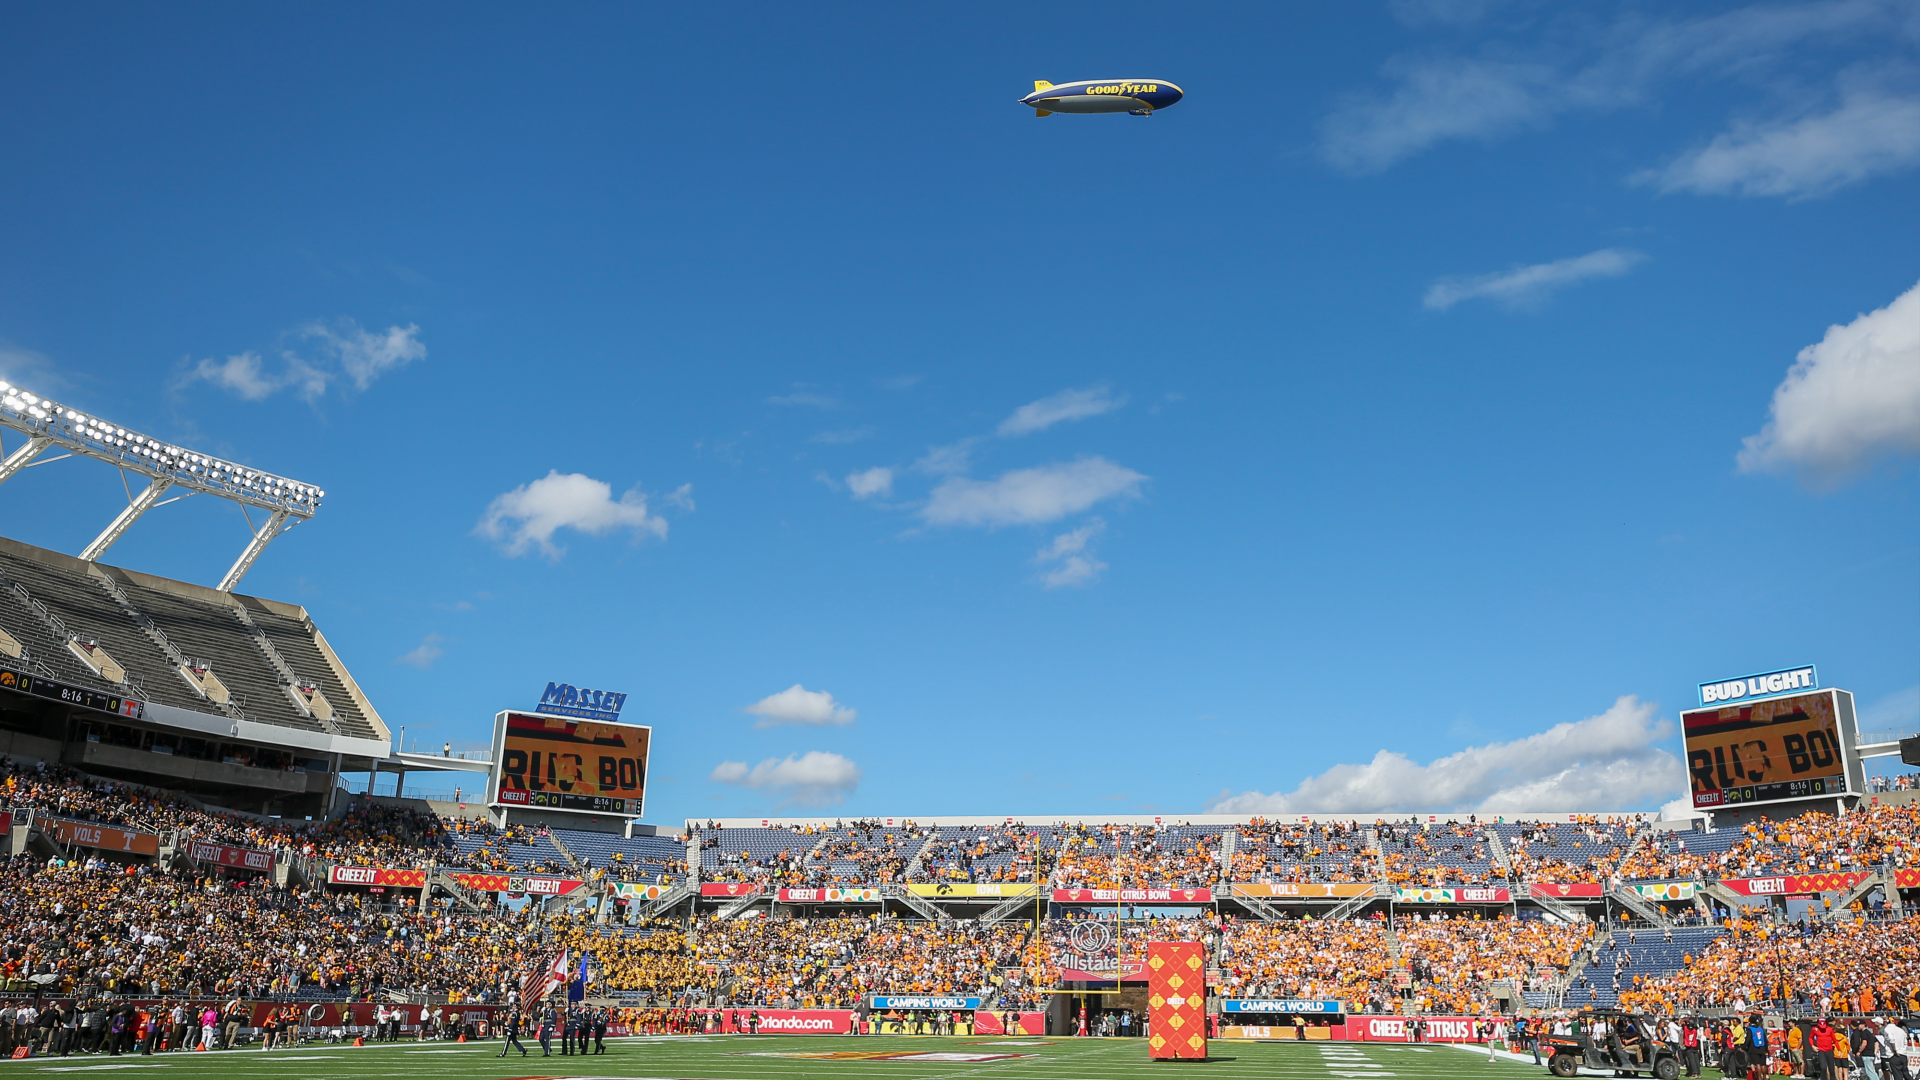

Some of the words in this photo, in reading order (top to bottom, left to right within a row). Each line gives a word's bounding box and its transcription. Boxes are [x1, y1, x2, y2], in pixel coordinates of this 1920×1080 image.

[1086, 83, 1157, 96] GOODYEAR
[22, 679, 27, 688] 0
[1702, 681, 1746, 702] BUD
[1748, 669, 1811, 695] LIGHT
[61, 689, 81, 702] 8:16
[540, 682, 627, 712] MASSEY
[111, 700, 116, 709] 0
[541, 706, 591, 717] SERVICES
[595, 712, 614, 720] INC.
[1790, 781, 1807, 791] 8:16
[1815, 782, 1821, 791] 0
[1745, 790, 1751, 798] 0
[552, 796, 558, 804] 0
[594, 798, 609, 806] 8:16
[616, 801, 621, 809] 0
[74, 826, 101, 844] VOLS
[511, 879, 523, 890] 25
[976, 884, 1001, 895] IOWA
[1270, 884, 1299, 895] VOLS
[1120, 890, 1147, 900] CITRUS
[1148, 890, 1172, 900] BOWL
[1057, 953, 1119, 971] Allstate
[887, 997, 930, 1008] CAMPING
[931, 997, 967, 1007] WORLD
[1239, 1001, 1287, 1012] CAMPING
[1287, 1001, 1325, 1012] WORLD
[1242, 1026, 1270, 1037] VOLS
